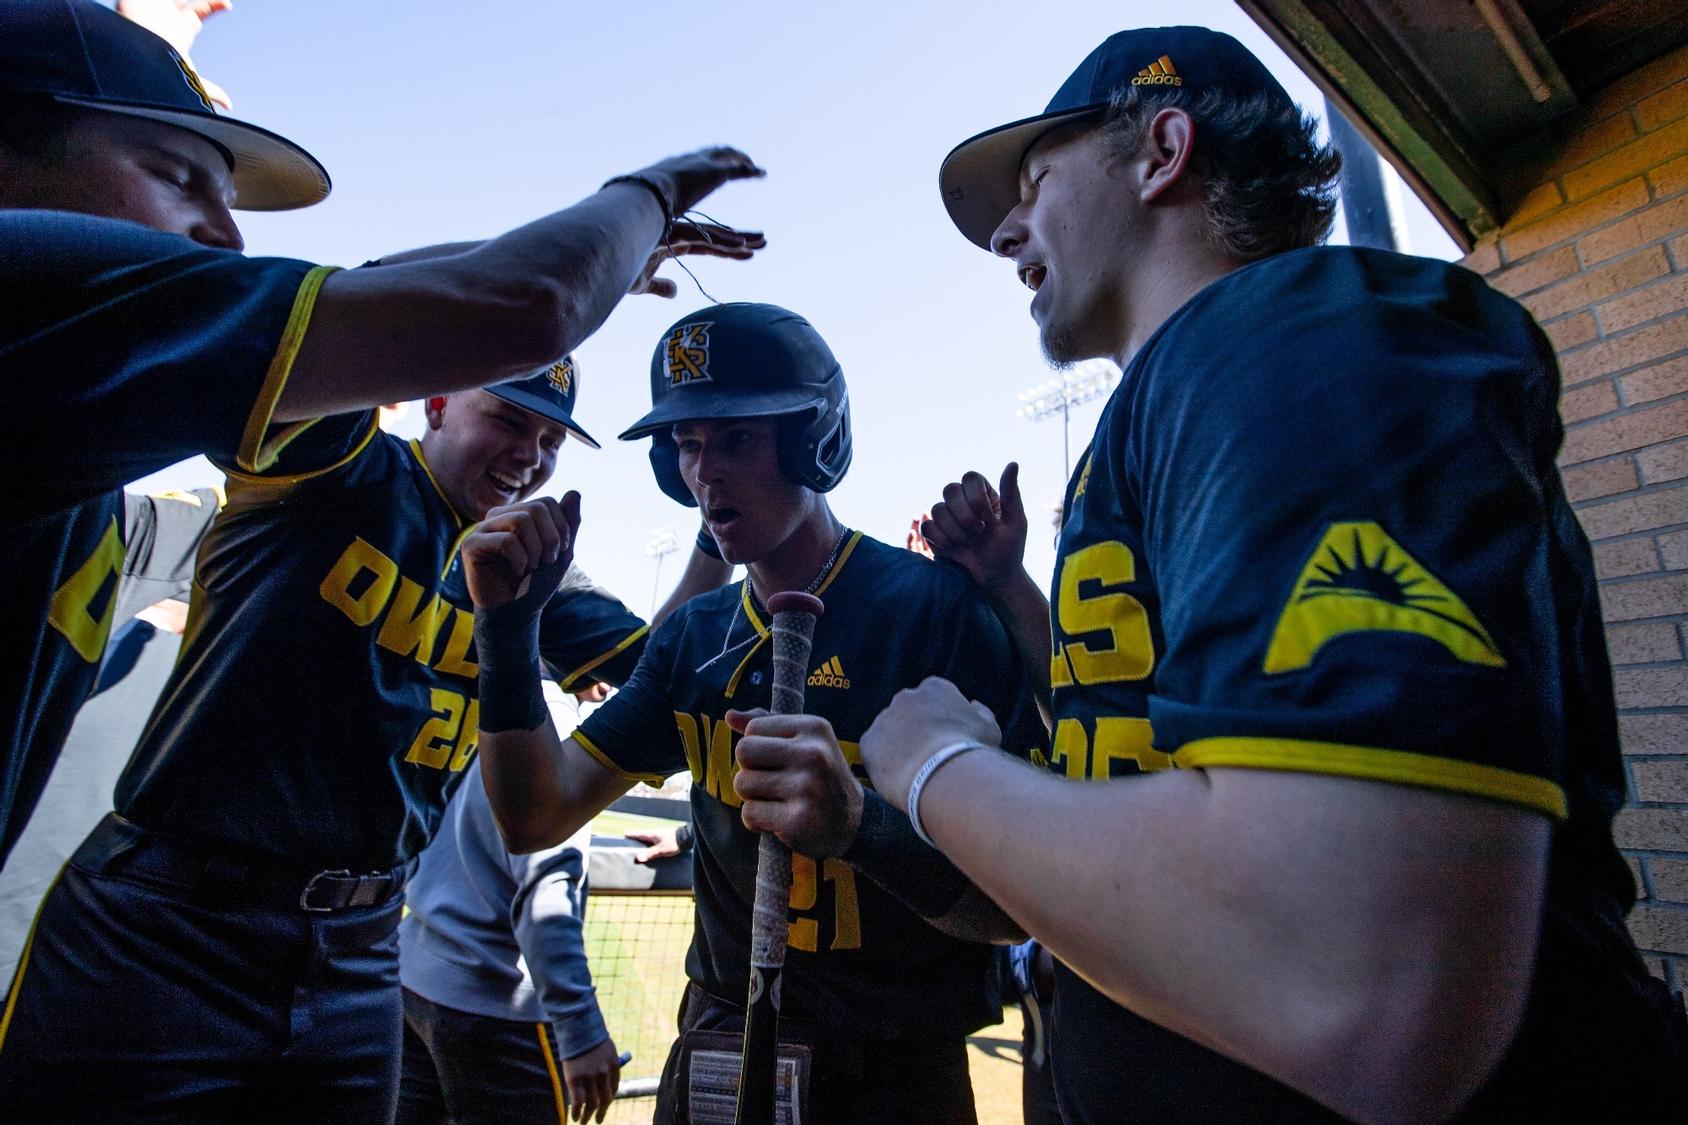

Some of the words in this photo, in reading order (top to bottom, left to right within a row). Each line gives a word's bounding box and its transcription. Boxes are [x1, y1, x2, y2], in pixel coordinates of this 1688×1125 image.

[1131, 73, 1182, 86] adidas
[319, 535, 480, 679] OWL
[807, 673, 850, 689] adidas
